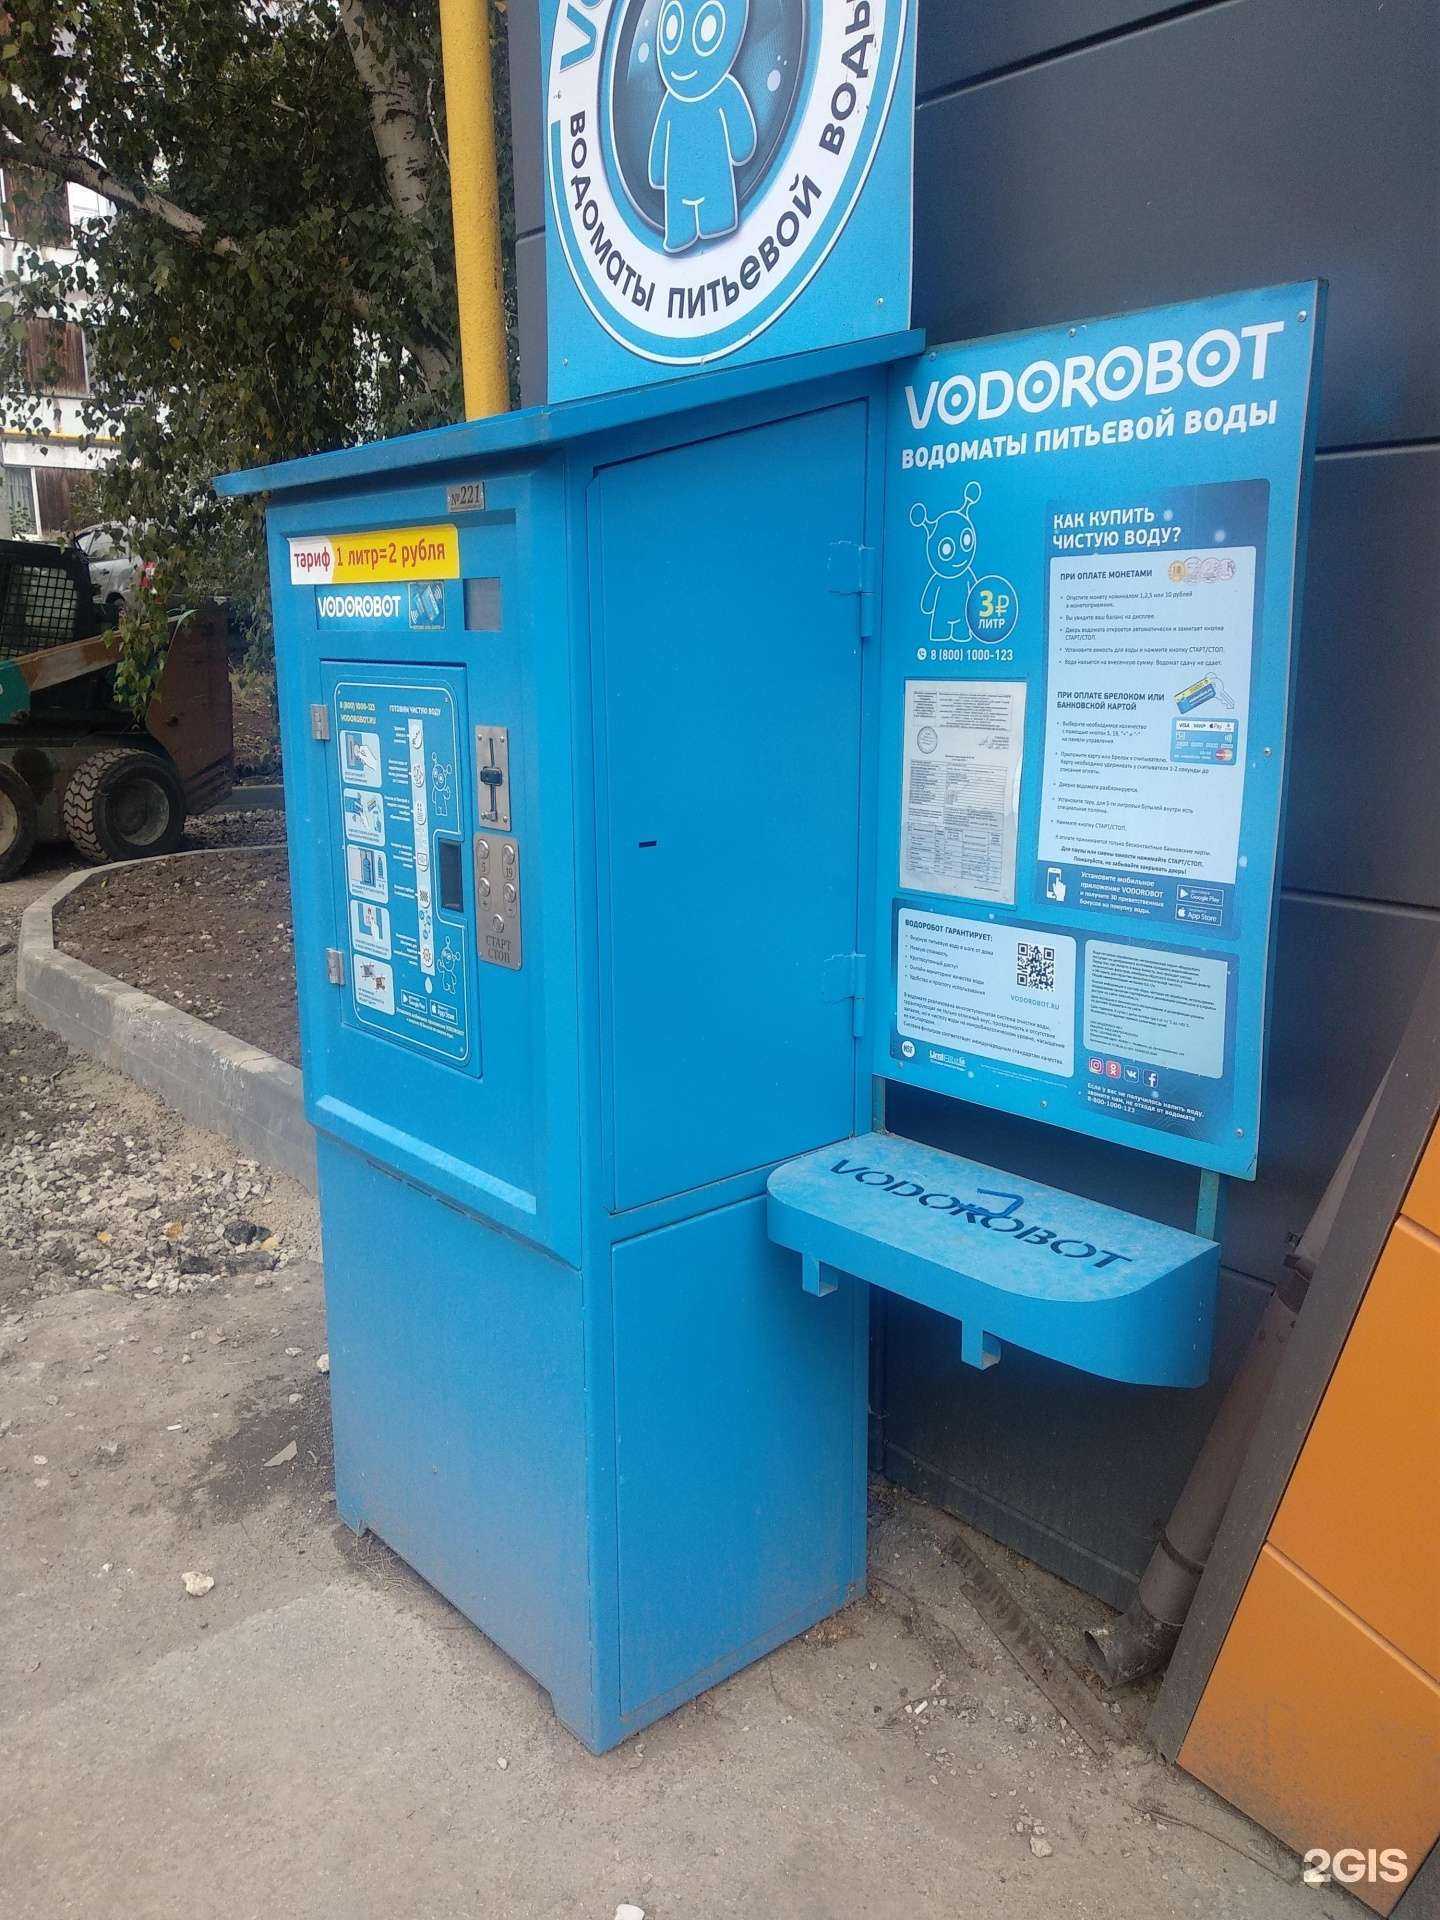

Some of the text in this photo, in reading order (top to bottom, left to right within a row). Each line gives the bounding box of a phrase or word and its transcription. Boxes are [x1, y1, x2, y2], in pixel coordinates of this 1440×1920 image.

[904, 320, 1285, 430] VODOROBOT
[901, 400, 1278, 470] ВОДОМАТЫ ПИТЬЕВОЙ ВОДЫ
[1053, 507, 1155, 530] КАК КУПИТЬ
[1052, 526, 1182, 549] ЧИСТУЮ ВОДУ?
[294, 546, 331, 572] тариф
[337, 547, 344, 567] 1
[402, 538, 446, 569] рубля
[1060, 569, 1153, 581] ПРИ ОПЛАТЕ МОНЕТАМИ
[317, 595, 402, 618] VODOROBOT
[978, 618, 1006, 630] ЛИТР
[930, 648, 1014, 661] 8 (800) 1000-123
[1056, 701, 1137, 711] БАНКОВСКОЙ КАРТОЙ
[1057, 691, 1165, 701] ПРИ ОПЛАТЕ БРЕЛОКОМ ИЛИ
[1187, 911, 1202, 921] App
[905, 919, 994, 943] ВОДОРОБОТ ГАРАНТИРУЕТ:
[829, 1158, 1134, 1269] VODOROBOT
